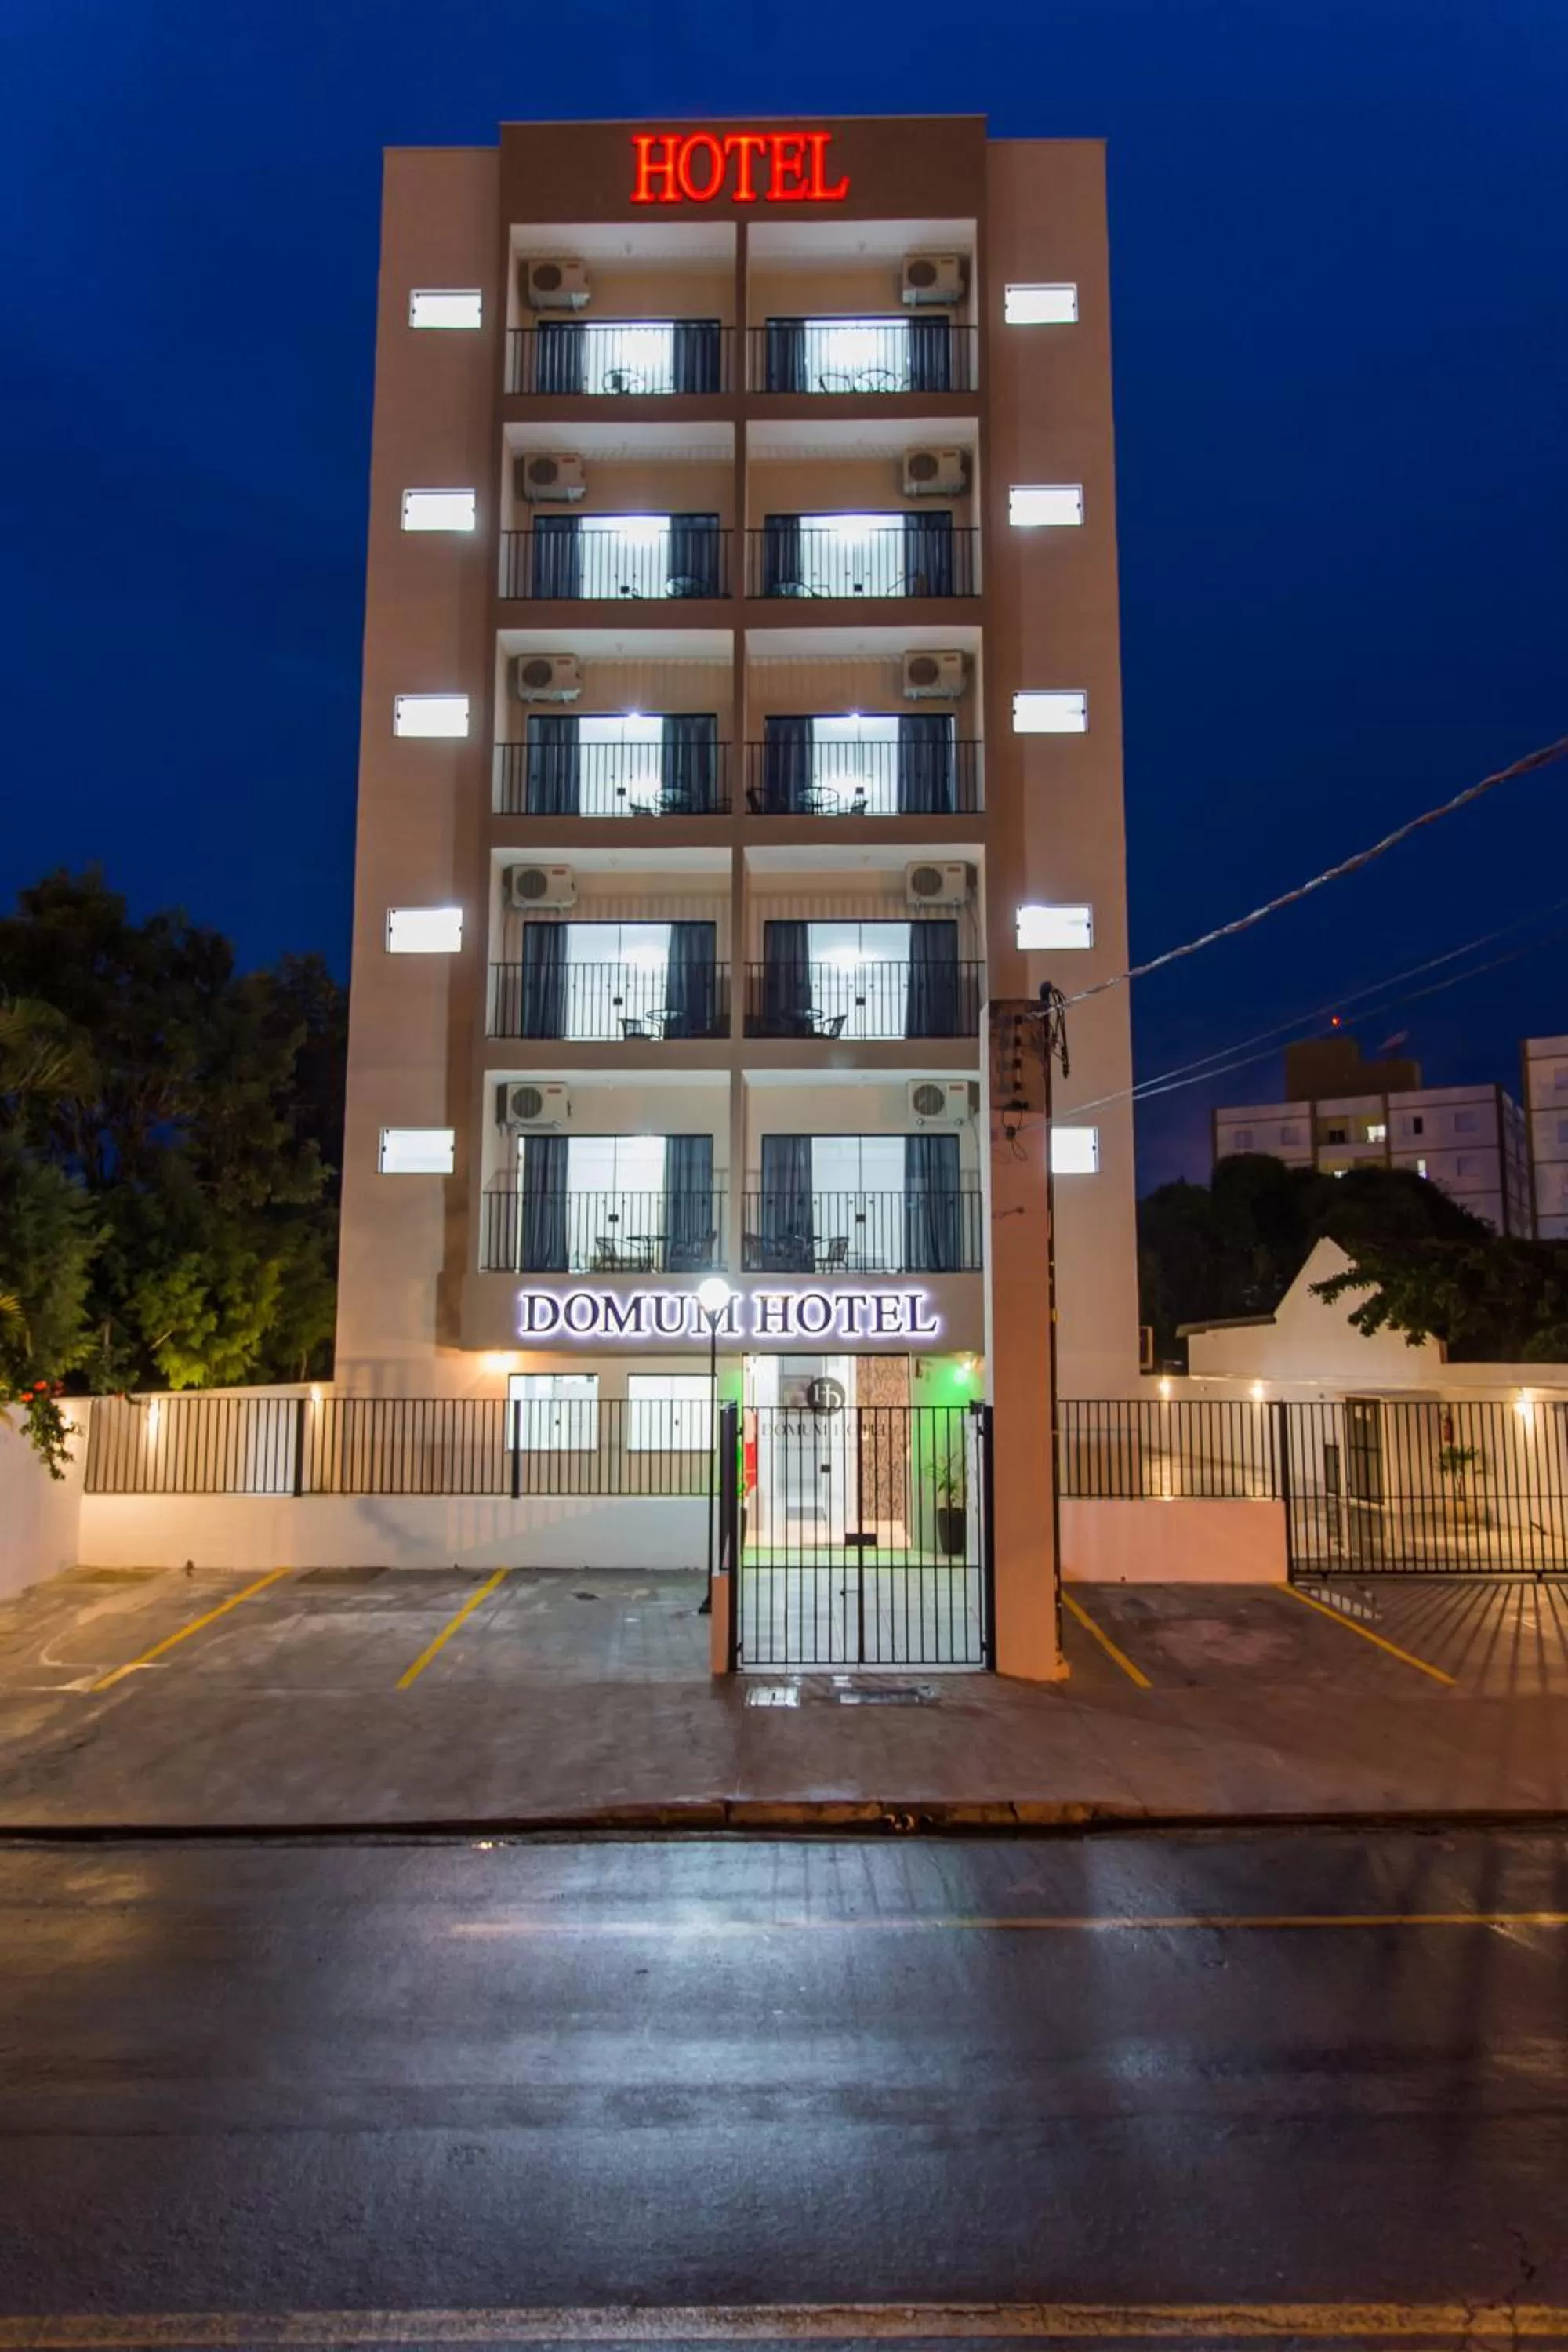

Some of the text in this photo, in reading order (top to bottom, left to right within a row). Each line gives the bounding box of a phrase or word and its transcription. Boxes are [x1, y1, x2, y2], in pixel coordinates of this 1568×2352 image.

[630, 130, 850, 203] HOTEL
[521, 1292, 938, 1334] DOMUM HOTEL
